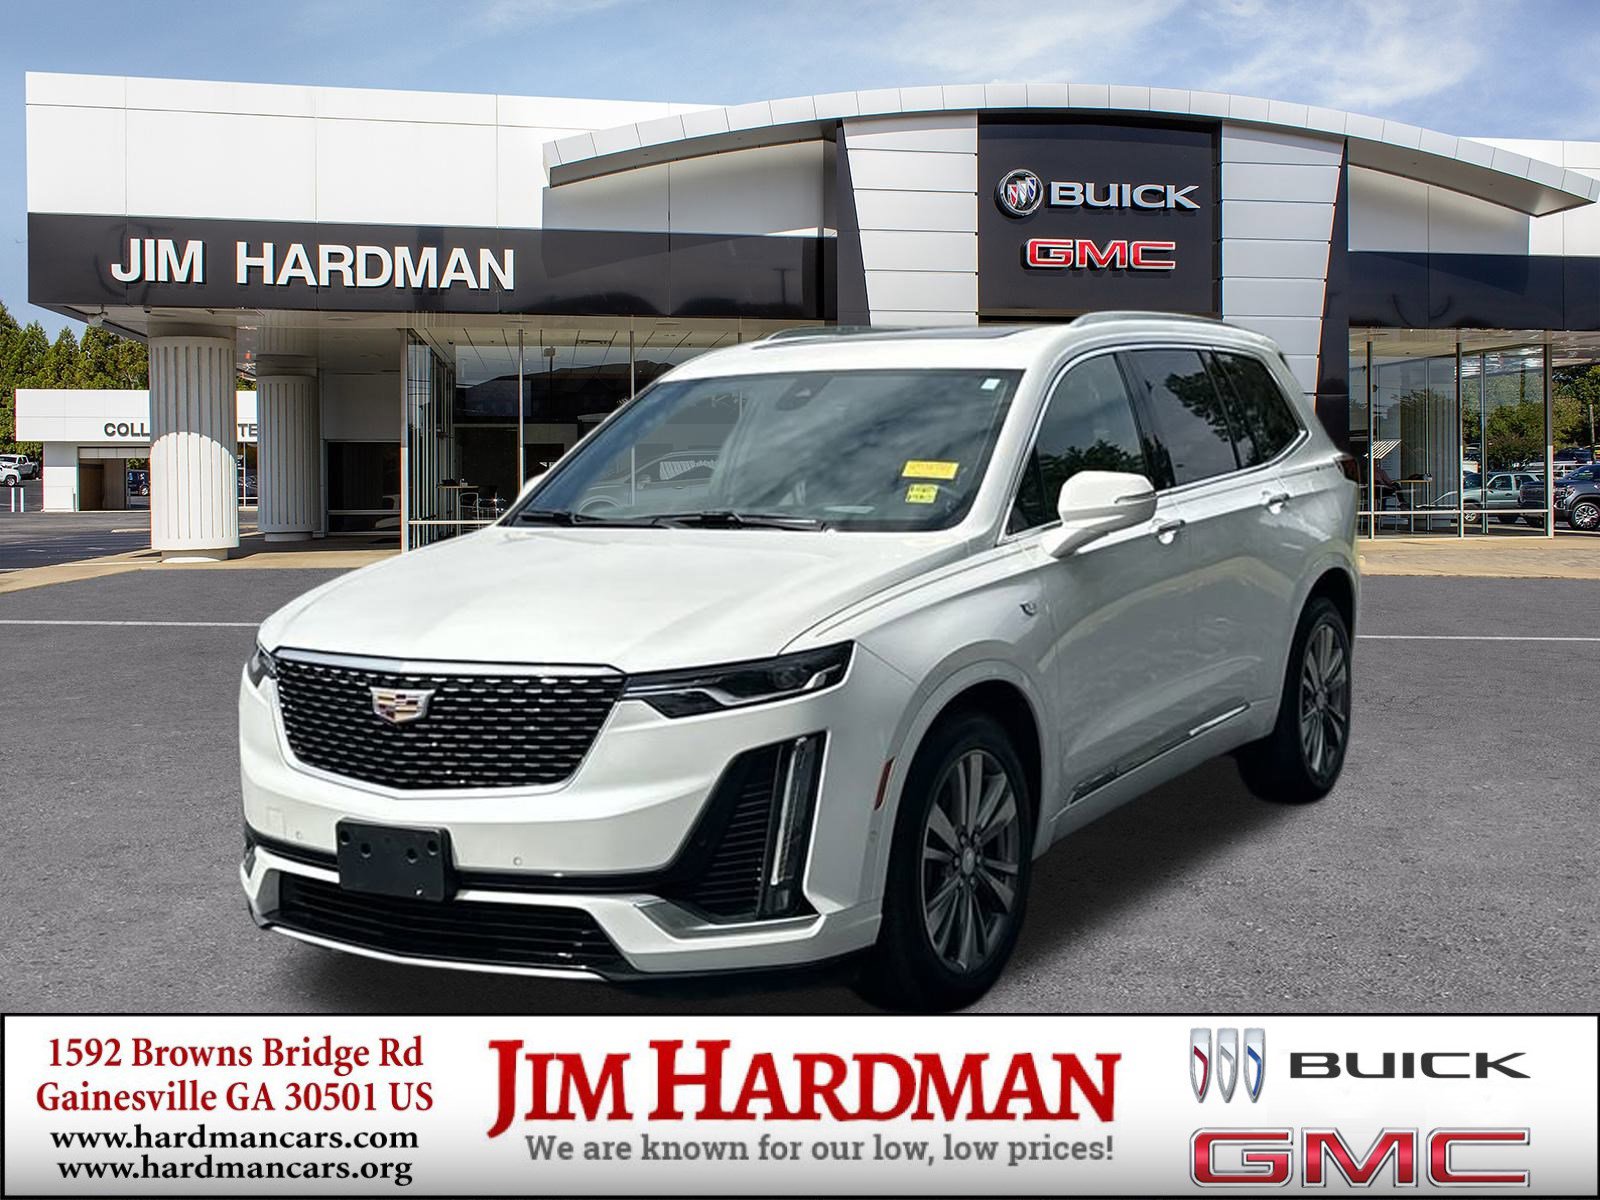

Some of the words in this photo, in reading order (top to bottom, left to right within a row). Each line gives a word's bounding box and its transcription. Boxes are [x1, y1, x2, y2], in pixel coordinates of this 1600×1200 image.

[1049, 180, 1201, 211] BUICK
[110, 237, 205, 284] JIM
[235, 241, 516, 291] HARDMAN
[1025, 237, 1177, 271] GMC
[103, 422, 150, 438] COLL
